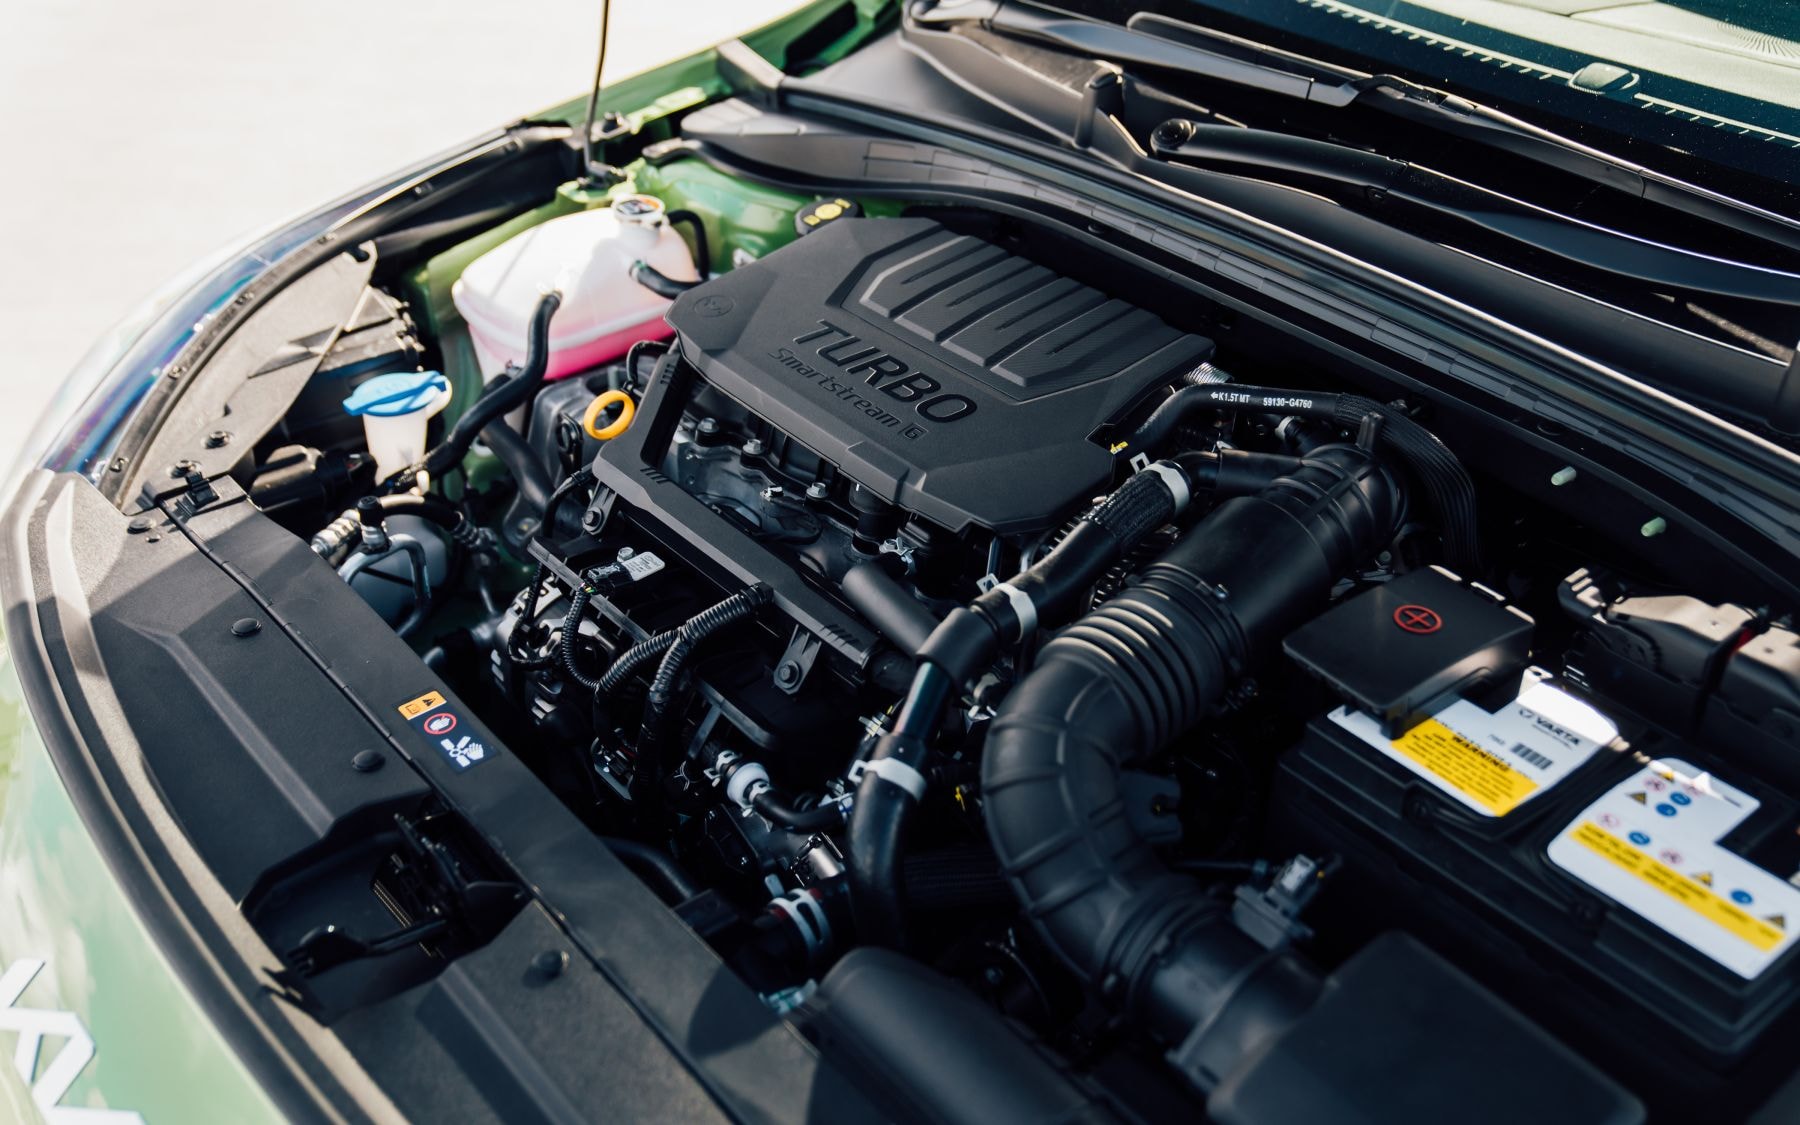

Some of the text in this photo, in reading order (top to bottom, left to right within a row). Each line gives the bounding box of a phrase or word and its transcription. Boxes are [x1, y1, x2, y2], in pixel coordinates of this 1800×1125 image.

[767, 347, 902, 429] Smartstream
[792, 318, 978, 424] TURBO
[1239, 394, 1251, 404] MT
[1262, 397, 1313, 409] 59130-G4760
[1537, 717, 1581, 746] VARTA
[1452, 735, 1510, 773] WARNING
